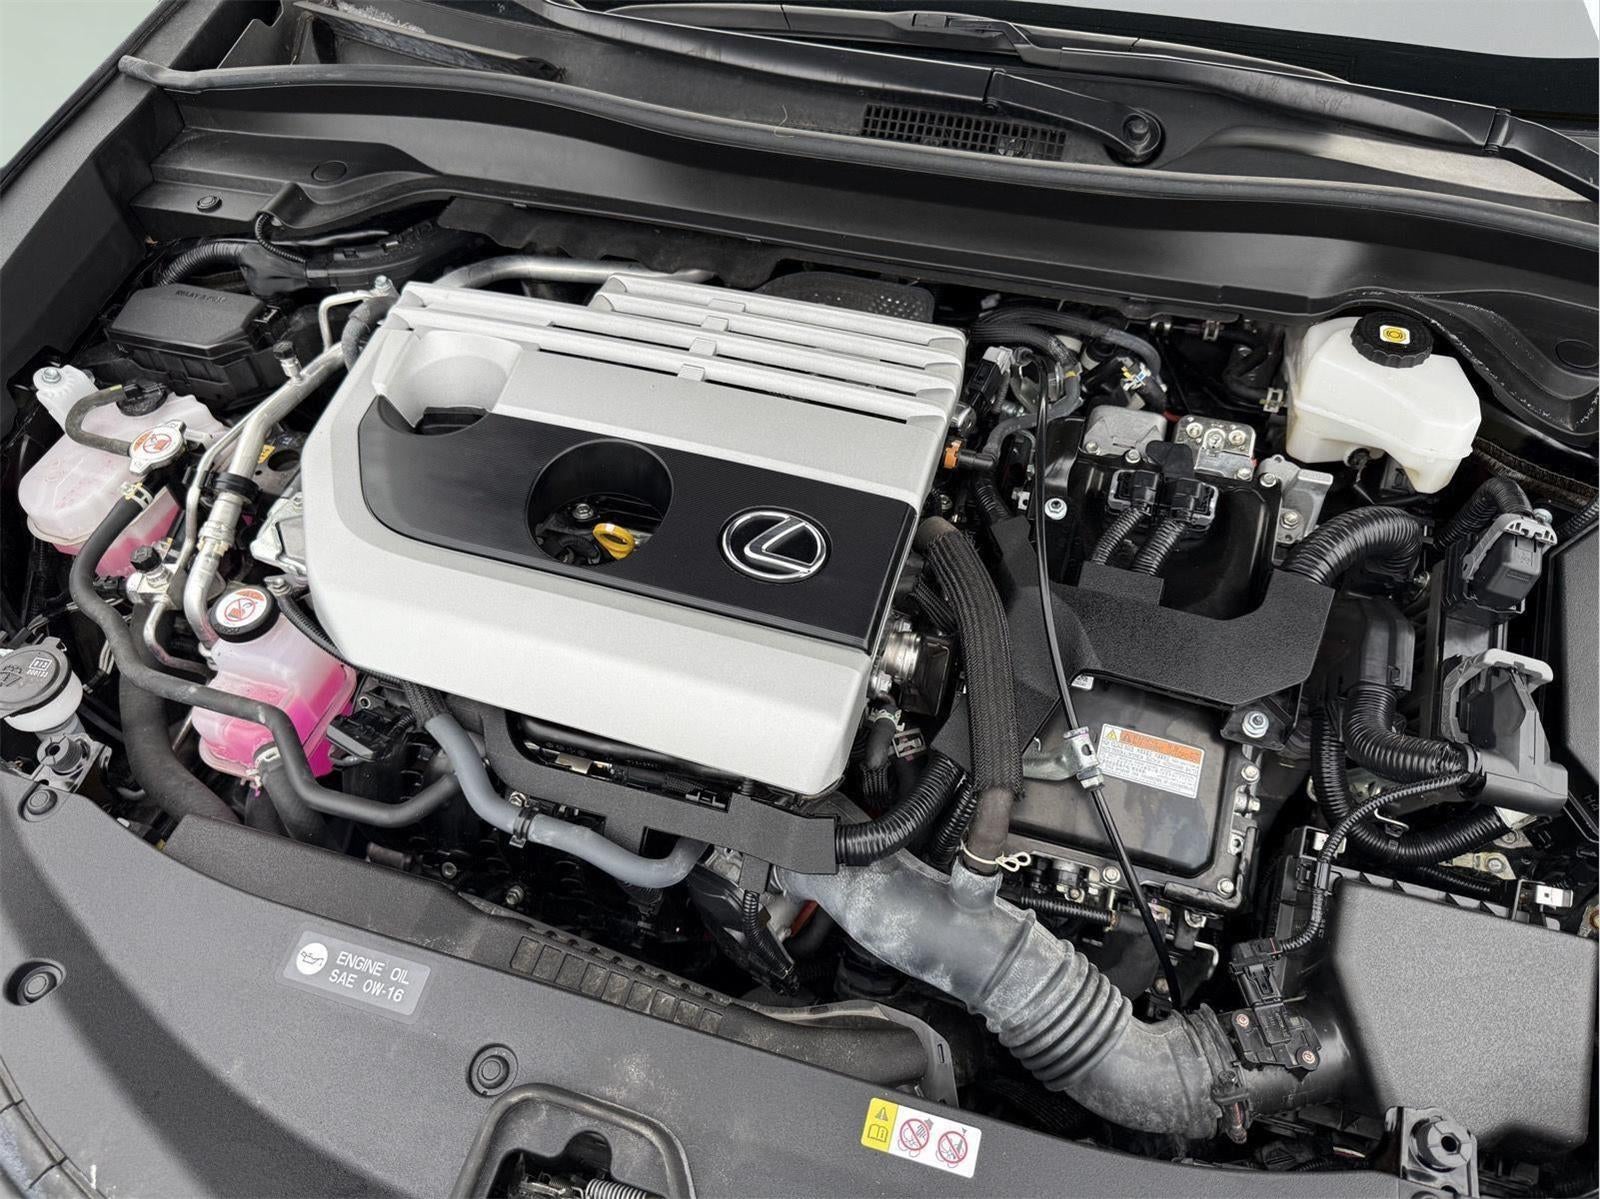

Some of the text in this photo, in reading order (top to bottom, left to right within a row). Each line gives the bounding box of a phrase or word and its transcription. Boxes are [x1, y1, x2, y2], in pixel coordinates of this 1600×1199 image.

[336, 951, 409, 984] ENGINE OIL
[329, 969, 404, 1001] SAE 0W-16
